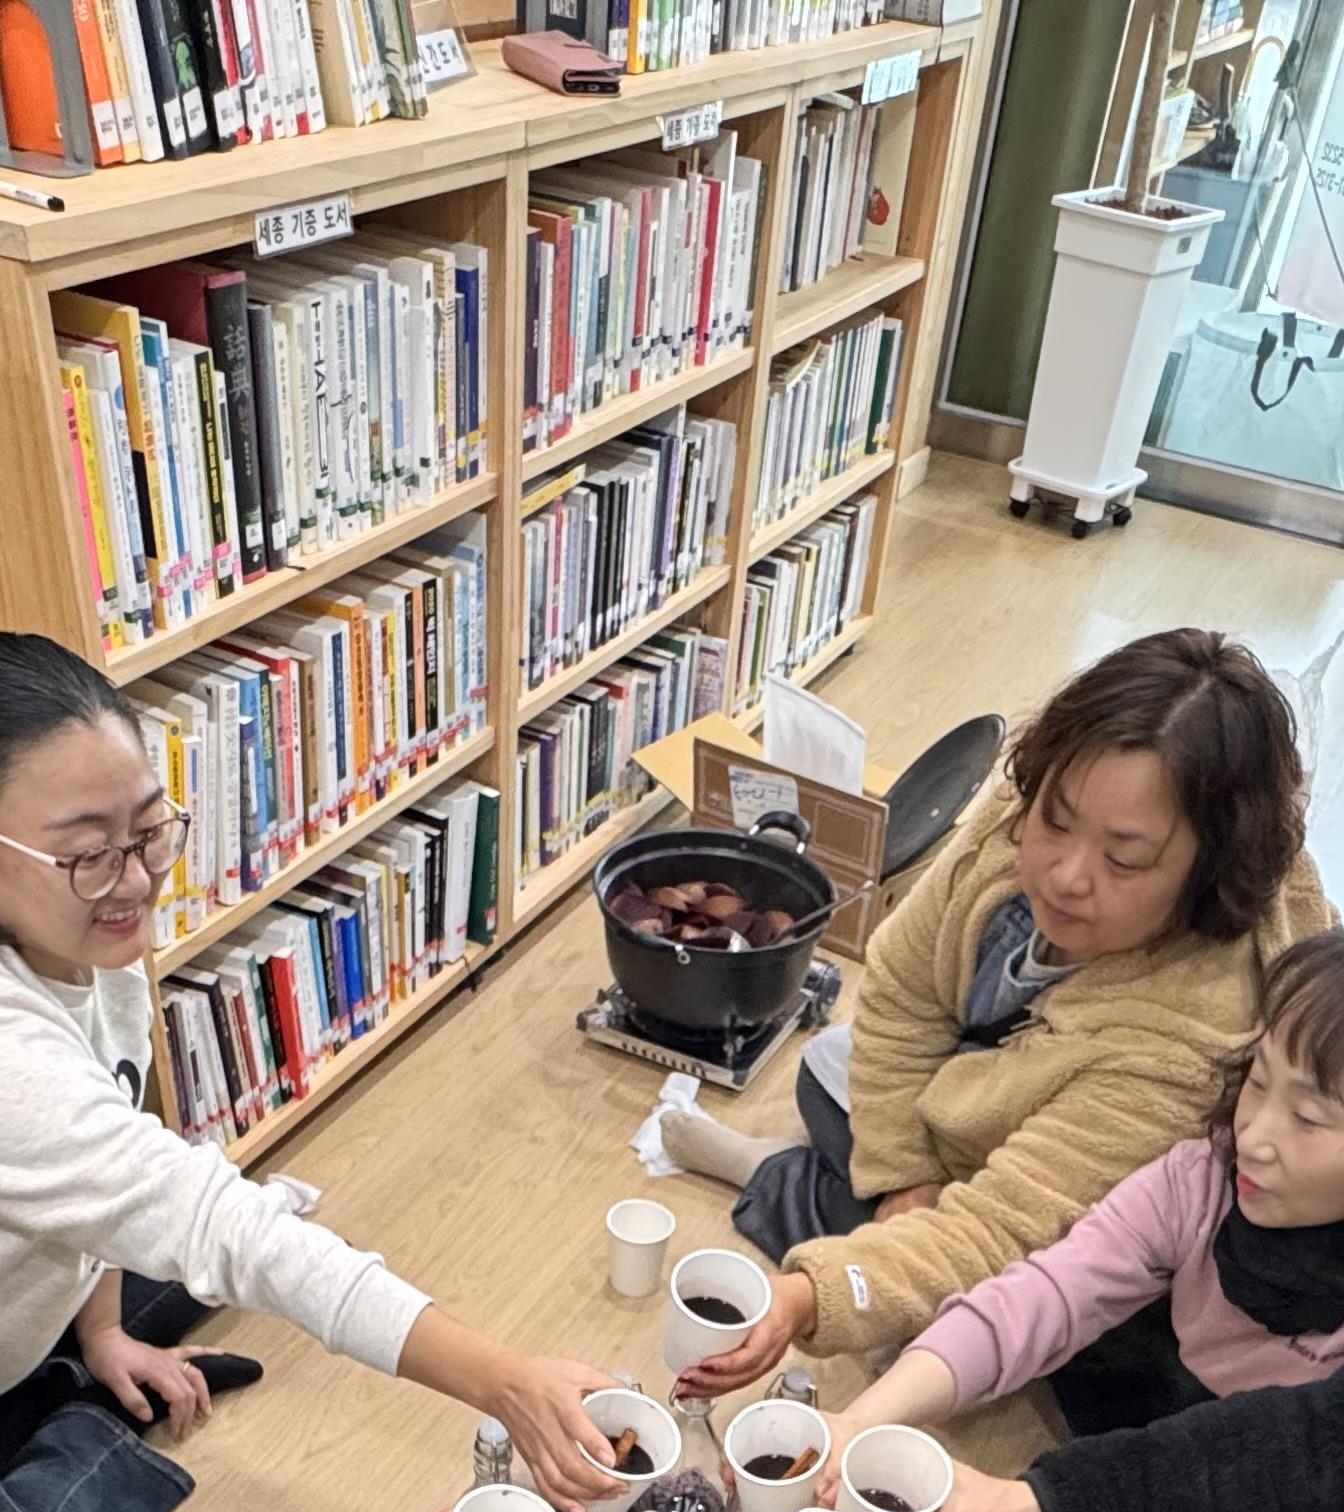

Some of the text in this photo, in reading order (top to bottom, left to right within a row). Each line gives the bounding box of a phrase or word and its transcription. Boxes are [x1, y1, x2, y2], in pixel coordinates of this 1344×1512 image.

[258, 200, 349, 246] 세종 기증 도서
